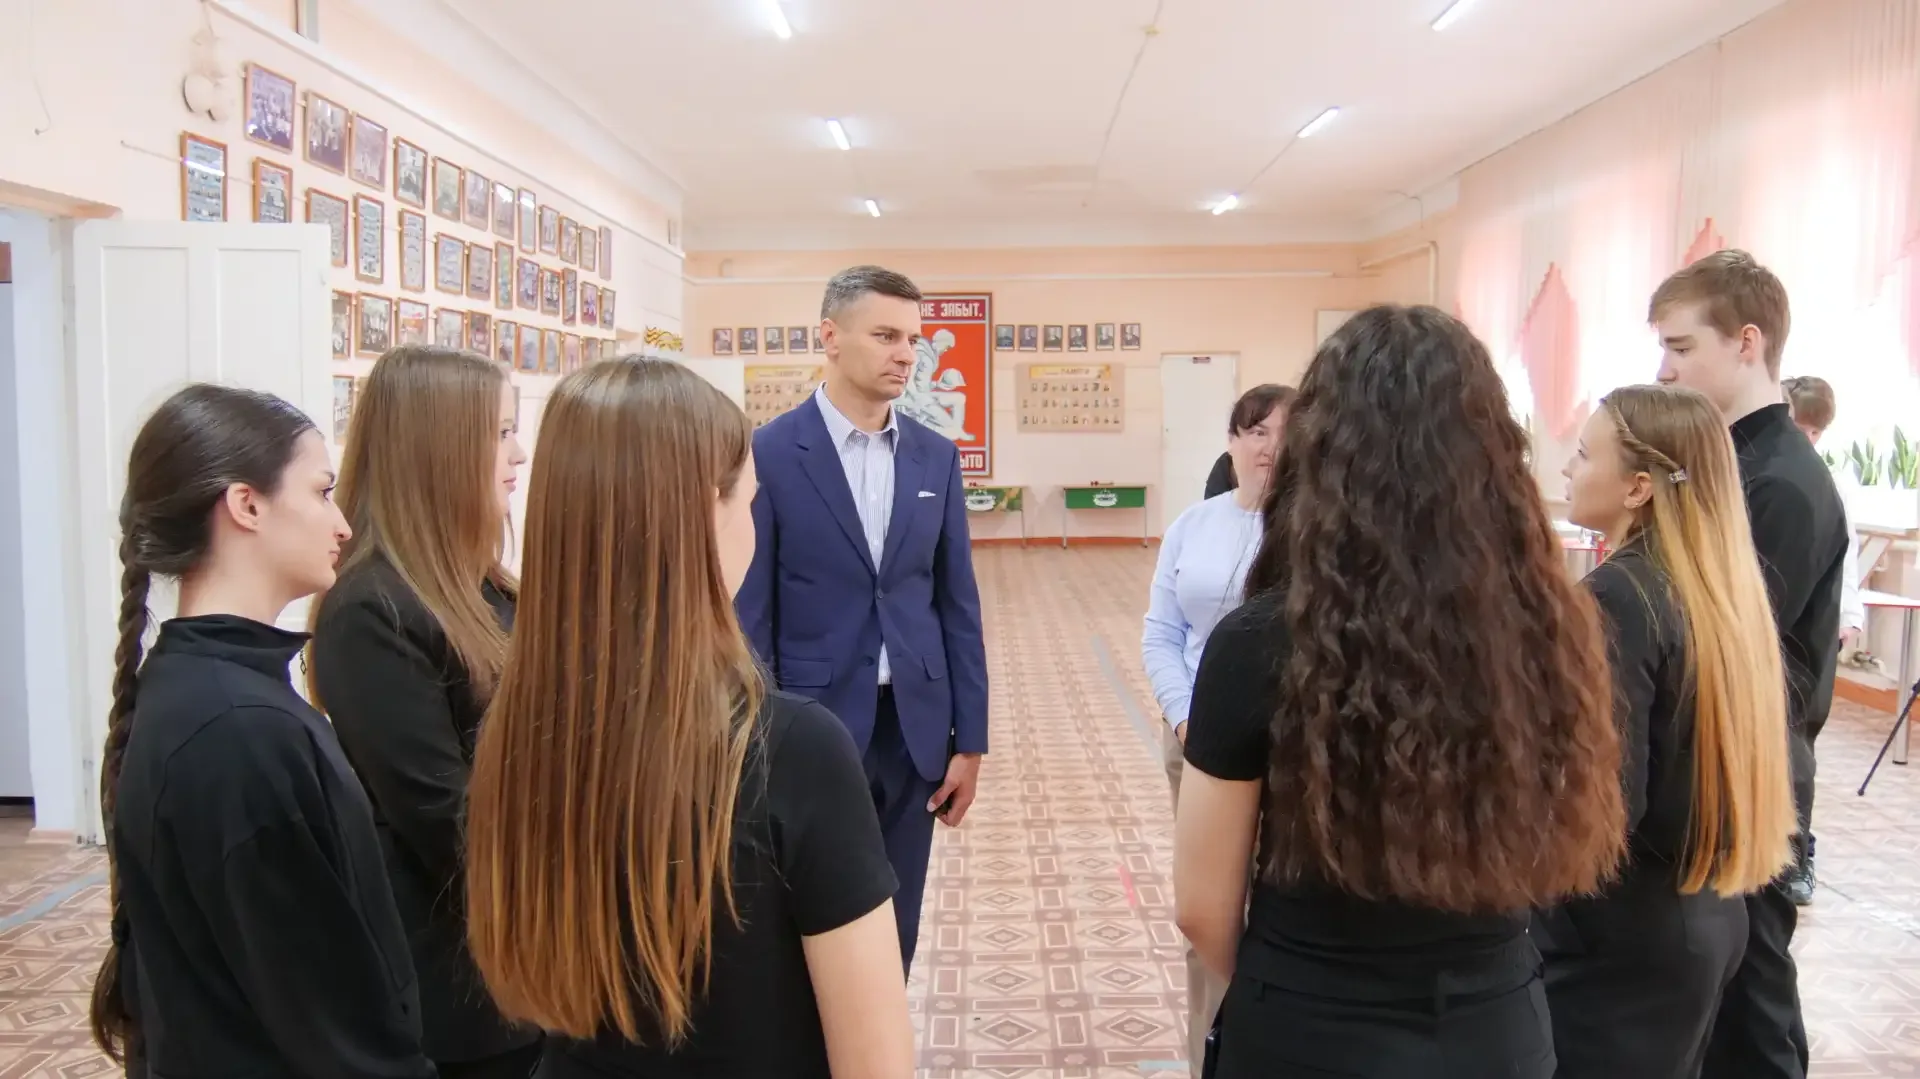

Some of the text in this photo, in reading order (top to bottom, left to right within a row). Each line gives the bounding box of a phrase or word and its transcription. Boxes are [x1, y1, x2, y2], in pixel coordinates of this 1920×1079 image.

[920, 303, 983, 317] НЕ ЗАБЫТ.
[960, 454, 984, 469] ЫТО
